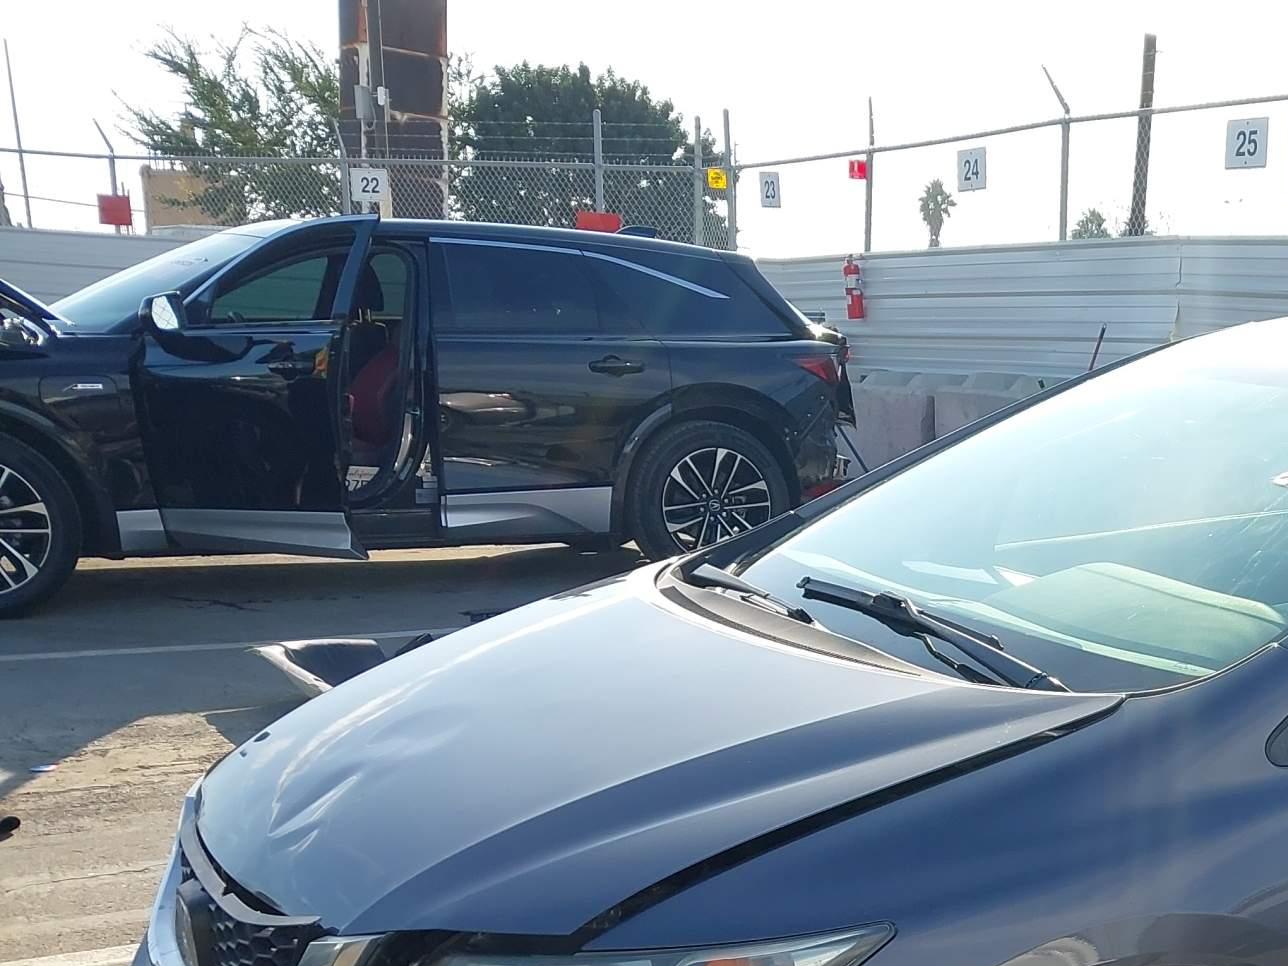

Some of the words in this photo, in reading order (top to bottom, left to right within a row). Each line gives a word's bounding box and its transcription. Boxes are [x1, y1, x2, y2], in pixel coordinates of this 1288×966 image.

[1235, 129, 1258, 156] 25
[963, 158, 979, 181] 24
[360, 176, 380, 193] 22
[764, 180, 776, 199] 23
